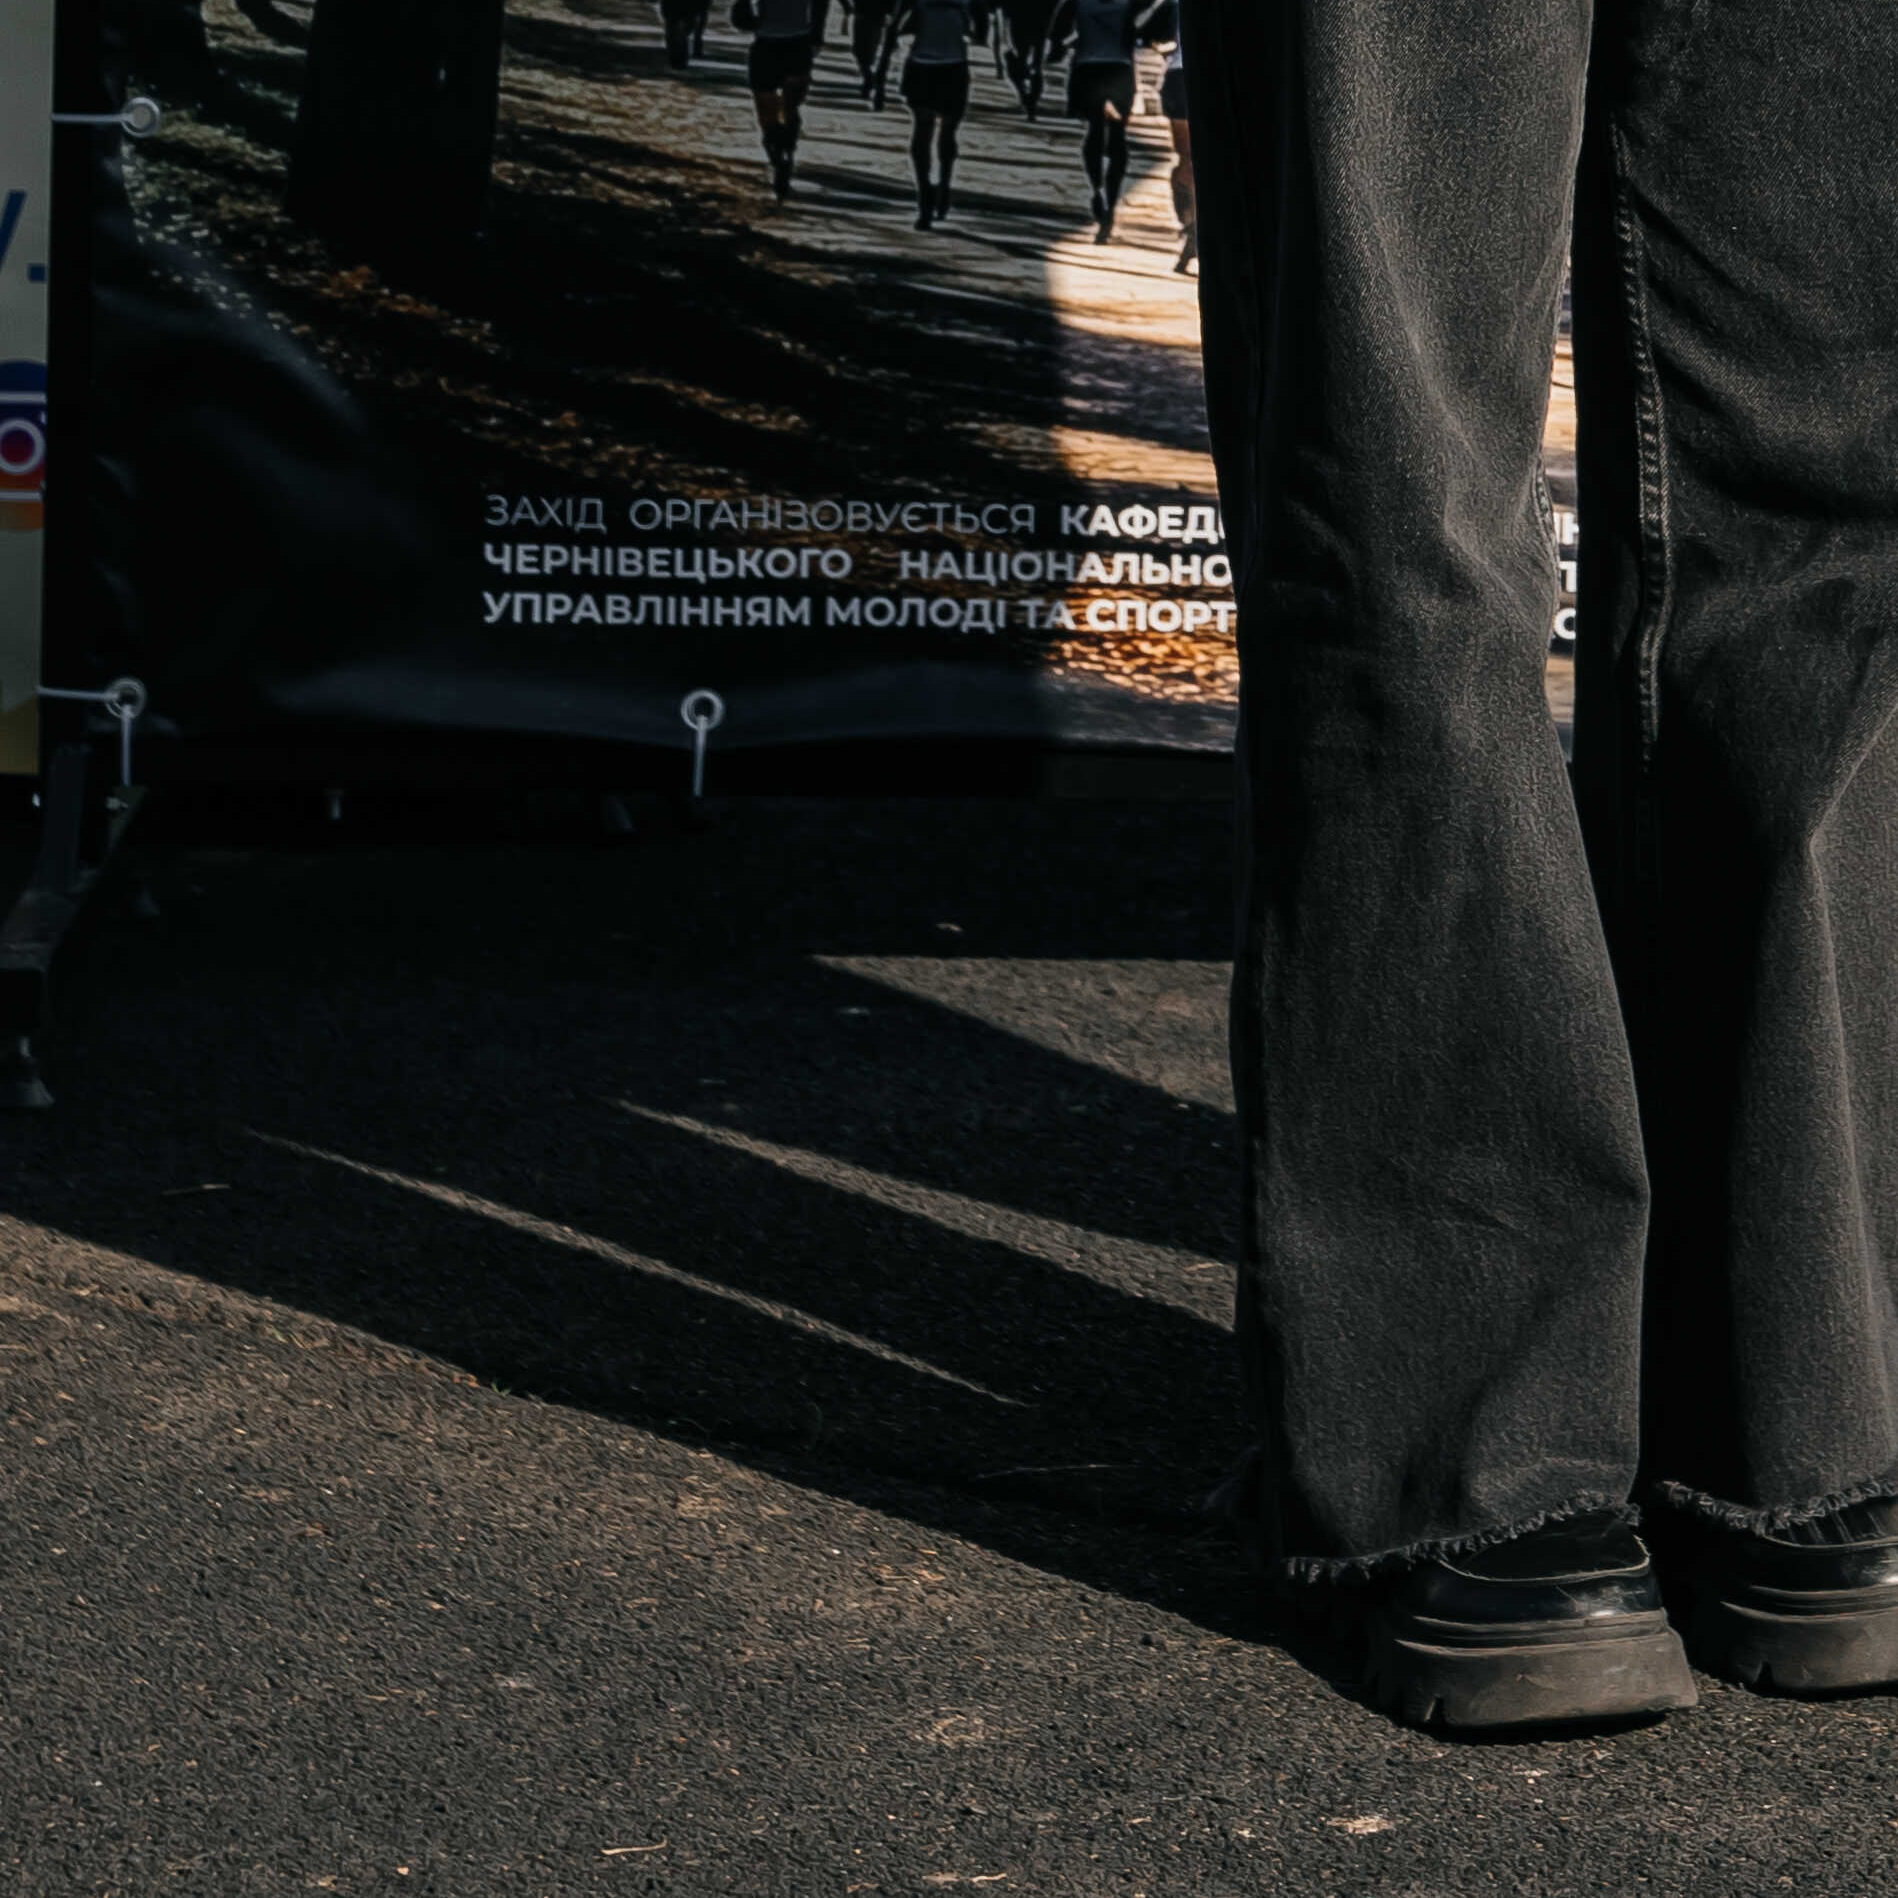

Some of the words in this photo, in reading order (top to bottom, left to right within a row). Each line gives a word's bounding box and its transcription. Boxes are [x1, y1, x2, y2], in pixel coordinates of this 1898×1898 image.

[484, 494, 607, 535] ЗАХІД
[629, 497, 1036, 536] ОРГАНІЗОВУЄТЬСЯ
[1061, 503, 1225, 545] КАФЕД
[484, 542, 853, 585] ЧЕРНІВЕЦЬКОГО
[900, 550, 1233, 587] НАЦІОНАЛЬНО
[483, 590, 811, 628] УПРАВЛІННЯМ
[826, 595, 1007, 635] МОЛОДІ
[1016, 598, 1078, 631] ТА
[1085, 598, 1238, 634] СПОРТ
